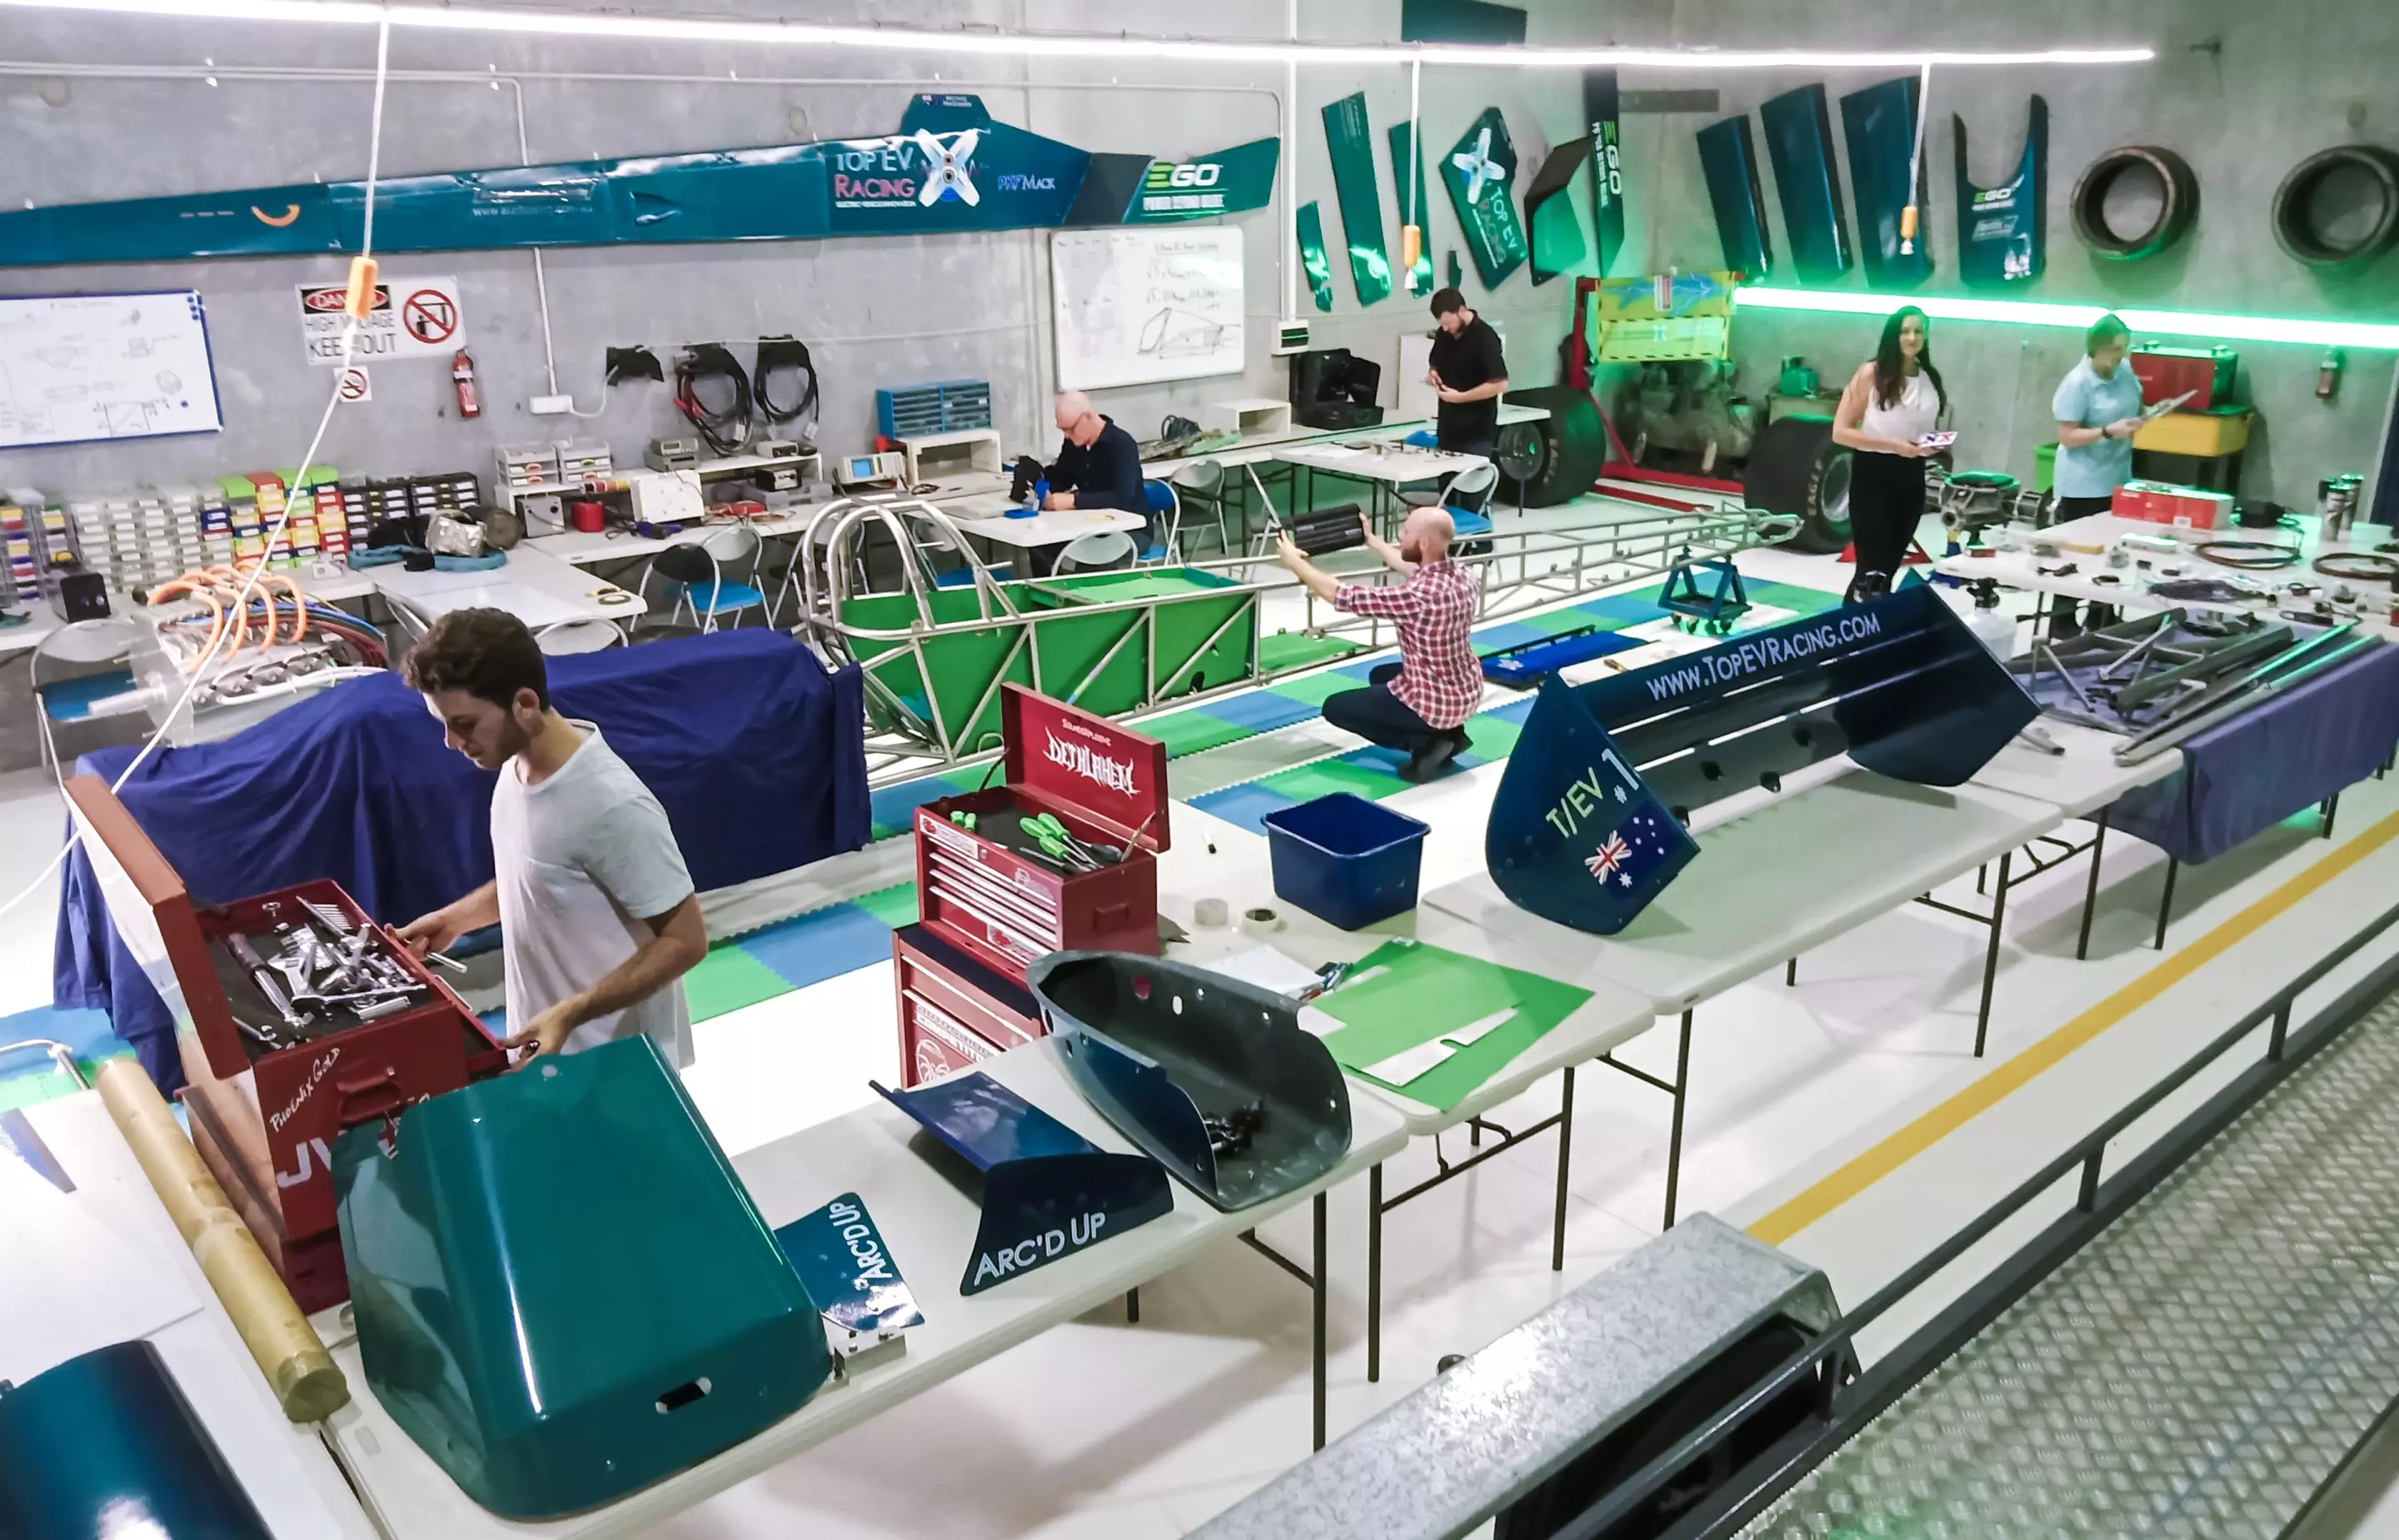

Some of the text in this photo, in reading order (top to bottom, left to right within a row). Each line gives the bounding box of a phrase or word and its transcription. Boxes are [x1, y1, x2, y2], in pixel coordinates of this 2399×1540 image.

[835, 146, 914, 172] TOP EV
[1603, 121, 1623, 195] EGO
[835, 173, 916, 198] RACING
[1146, 163, 1221, 188] EGO
[1973, 187, 2012, 202] EGO
[1489, 186, 1518, 249] TOP EV
[305, 316, 336, 332] HIGH
[310, 332, 397, 357] KEE OUT
[1545, 766, 1603, 839] T/EV
[829, 1202, 893, 1278] ARC'D UP
[974, 1212, 1106, 1287] ARC'D UP
